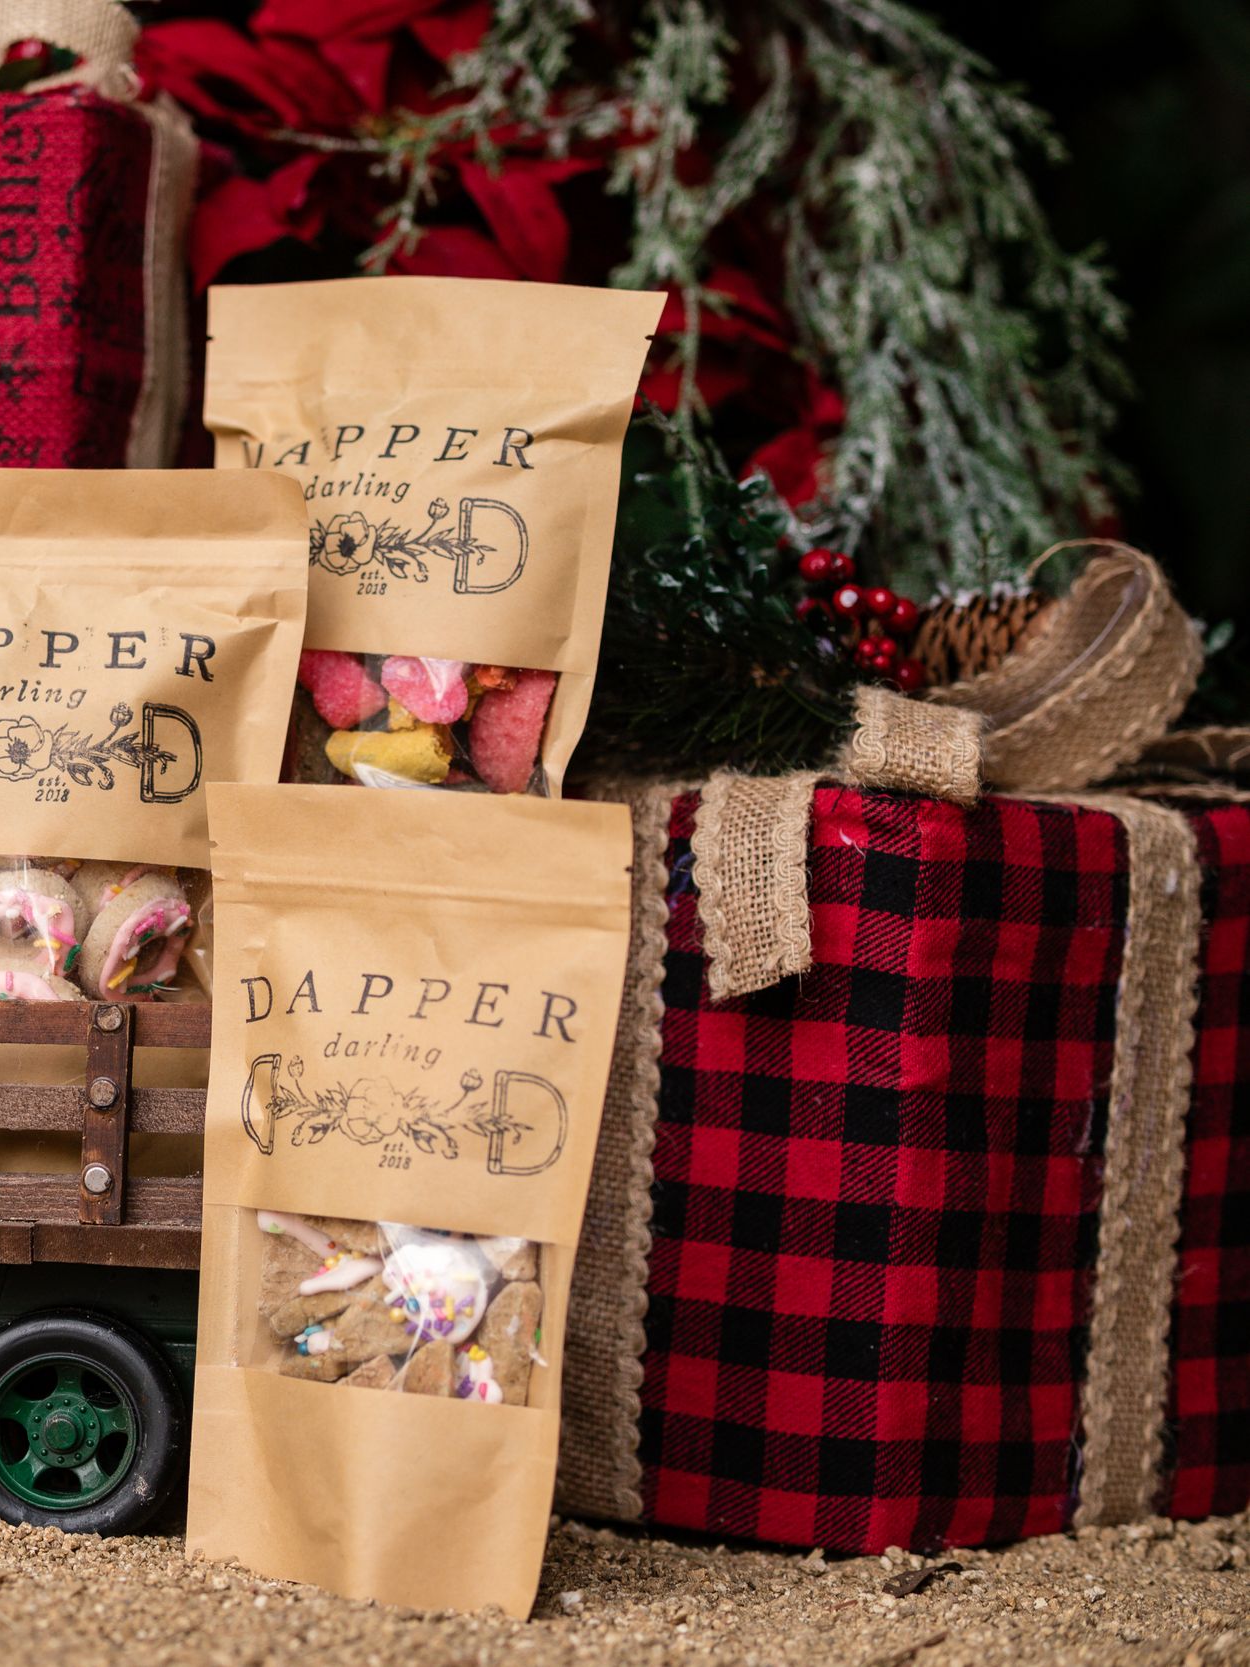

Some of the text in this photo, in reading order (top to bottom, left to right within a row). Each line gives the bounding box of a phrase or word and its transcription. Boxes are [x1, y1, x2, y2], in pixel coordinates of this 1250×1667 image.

[305, 473, 412, 503] darling
[356, 582, 388, 595] 2018
[34, 788, 70, 803] 2018
[240, 969, 579, 1044] DAPPER
[323, 1032, 443, 1070] darling
[378, 1155, 411, 1170] 2018
